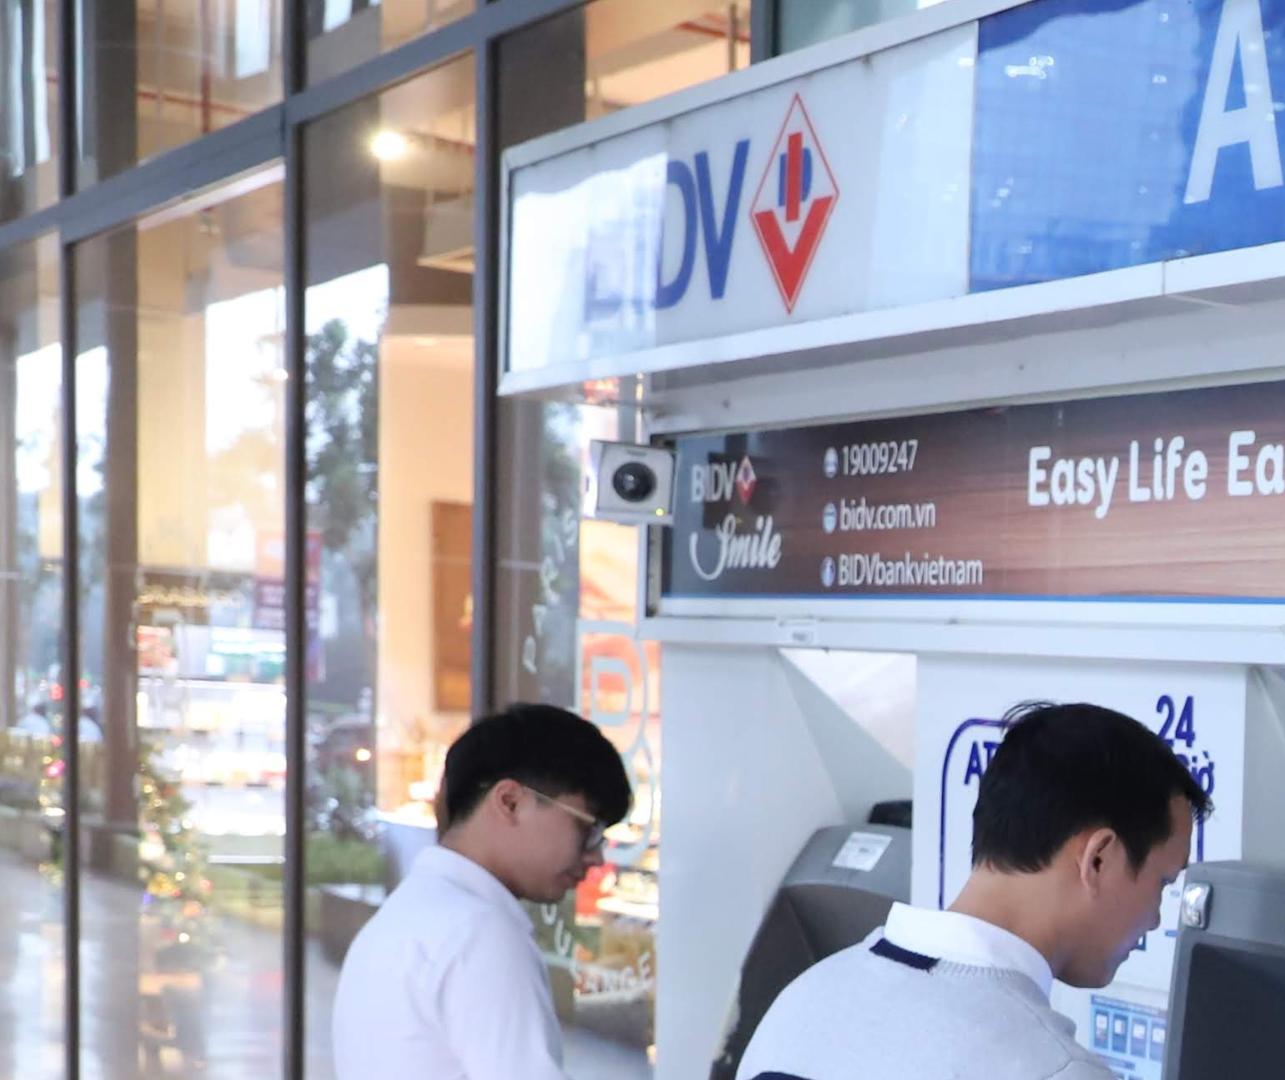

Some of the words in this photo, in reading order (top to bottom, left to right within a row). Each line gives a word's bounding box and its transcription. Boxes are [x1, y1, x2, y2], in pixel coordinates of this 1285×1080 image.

[841, 439, 918, 476] 19009247
[1028, 446, 1119, 519] Easy
[1128, 436, 1208, 502] Life
[691, 461, 737, 502] BIDV
[839, 498, 937, 531] bidv.com.vn
[689, 514, 782, 580] Smile
[838, 552, 983, 586] BIDVbankvietnam
[1157, 695, 1195, 748] 24
[964, 741, 1002, 785] AT
